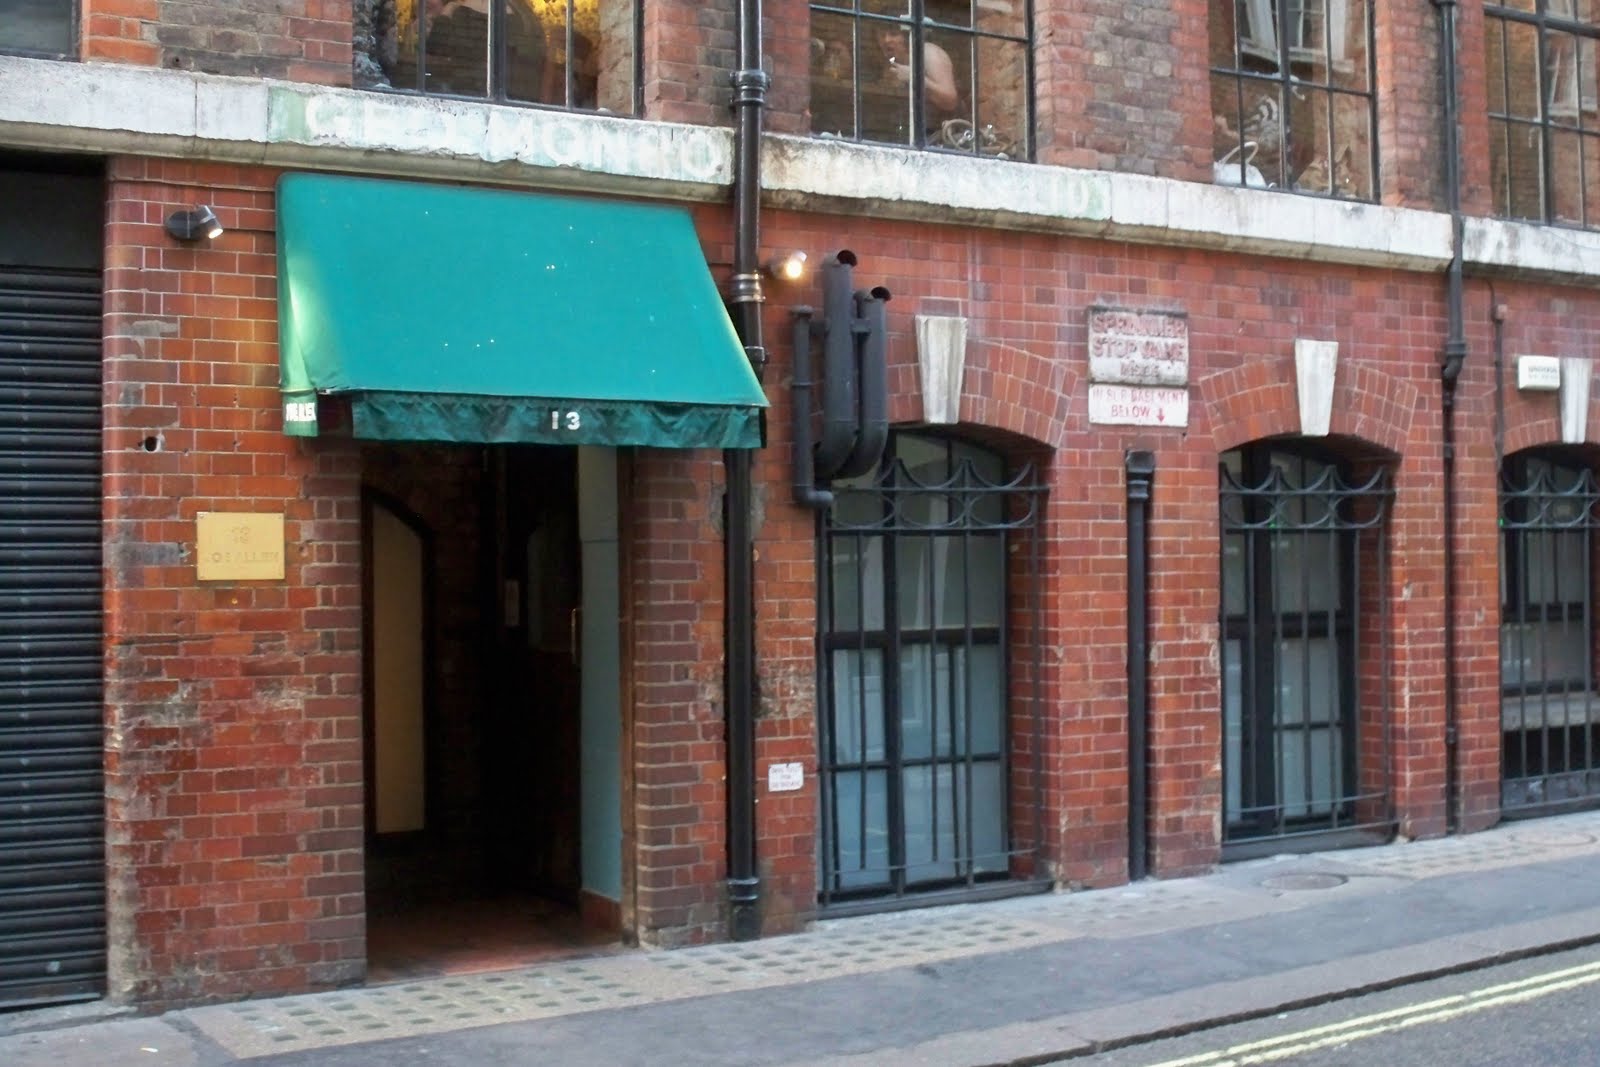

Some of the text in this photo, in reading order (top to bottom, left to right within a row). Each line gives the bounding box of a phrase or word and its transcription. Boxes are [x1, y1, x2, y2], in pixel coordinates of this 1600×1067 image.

[1092, 337, 1138, 359] STOP
[551, 410, 581, 431] 13
[1111, 405, 1151, 418] BELOW
